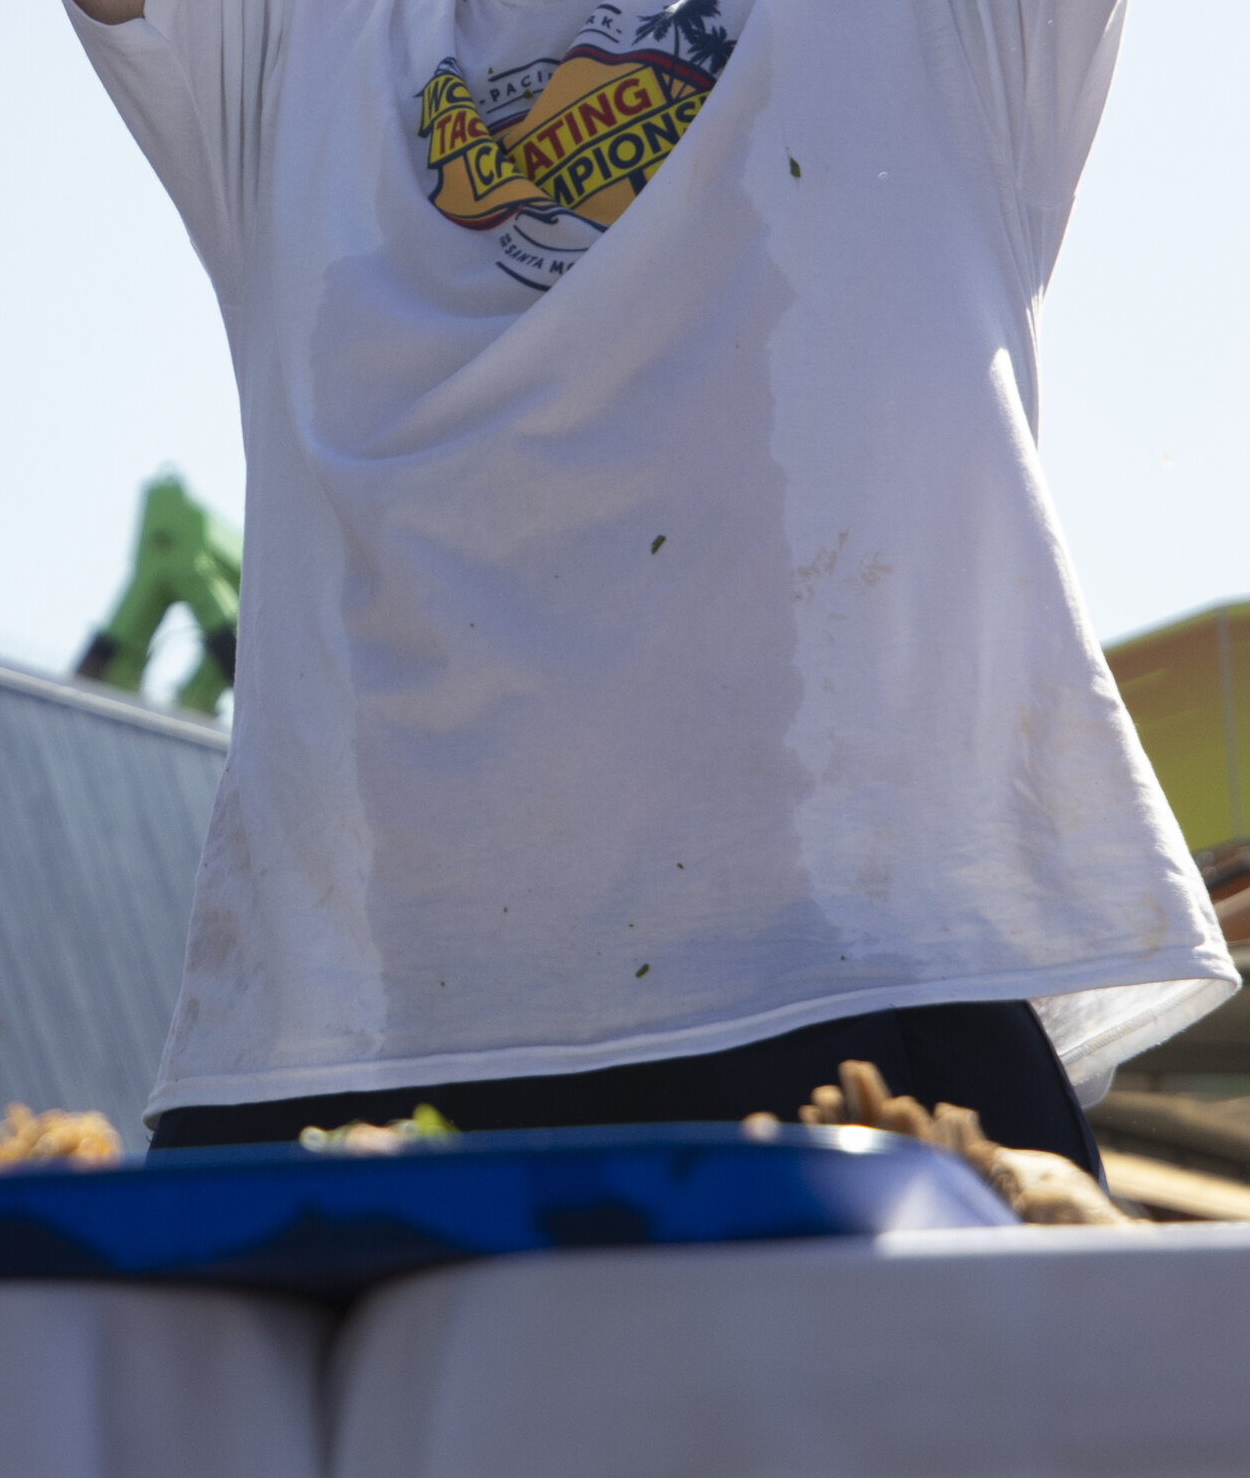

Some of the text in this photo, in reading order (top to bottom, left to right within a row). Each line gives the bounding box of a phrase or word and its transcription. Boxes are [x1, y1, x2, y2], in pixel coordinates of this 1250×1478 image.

[490, 71, 553, 102] PACI
[508, 78, 653, 182] ATING
[551, 95, 708, 206] MPIONS
[504, 243, 545, 270] SANTA
